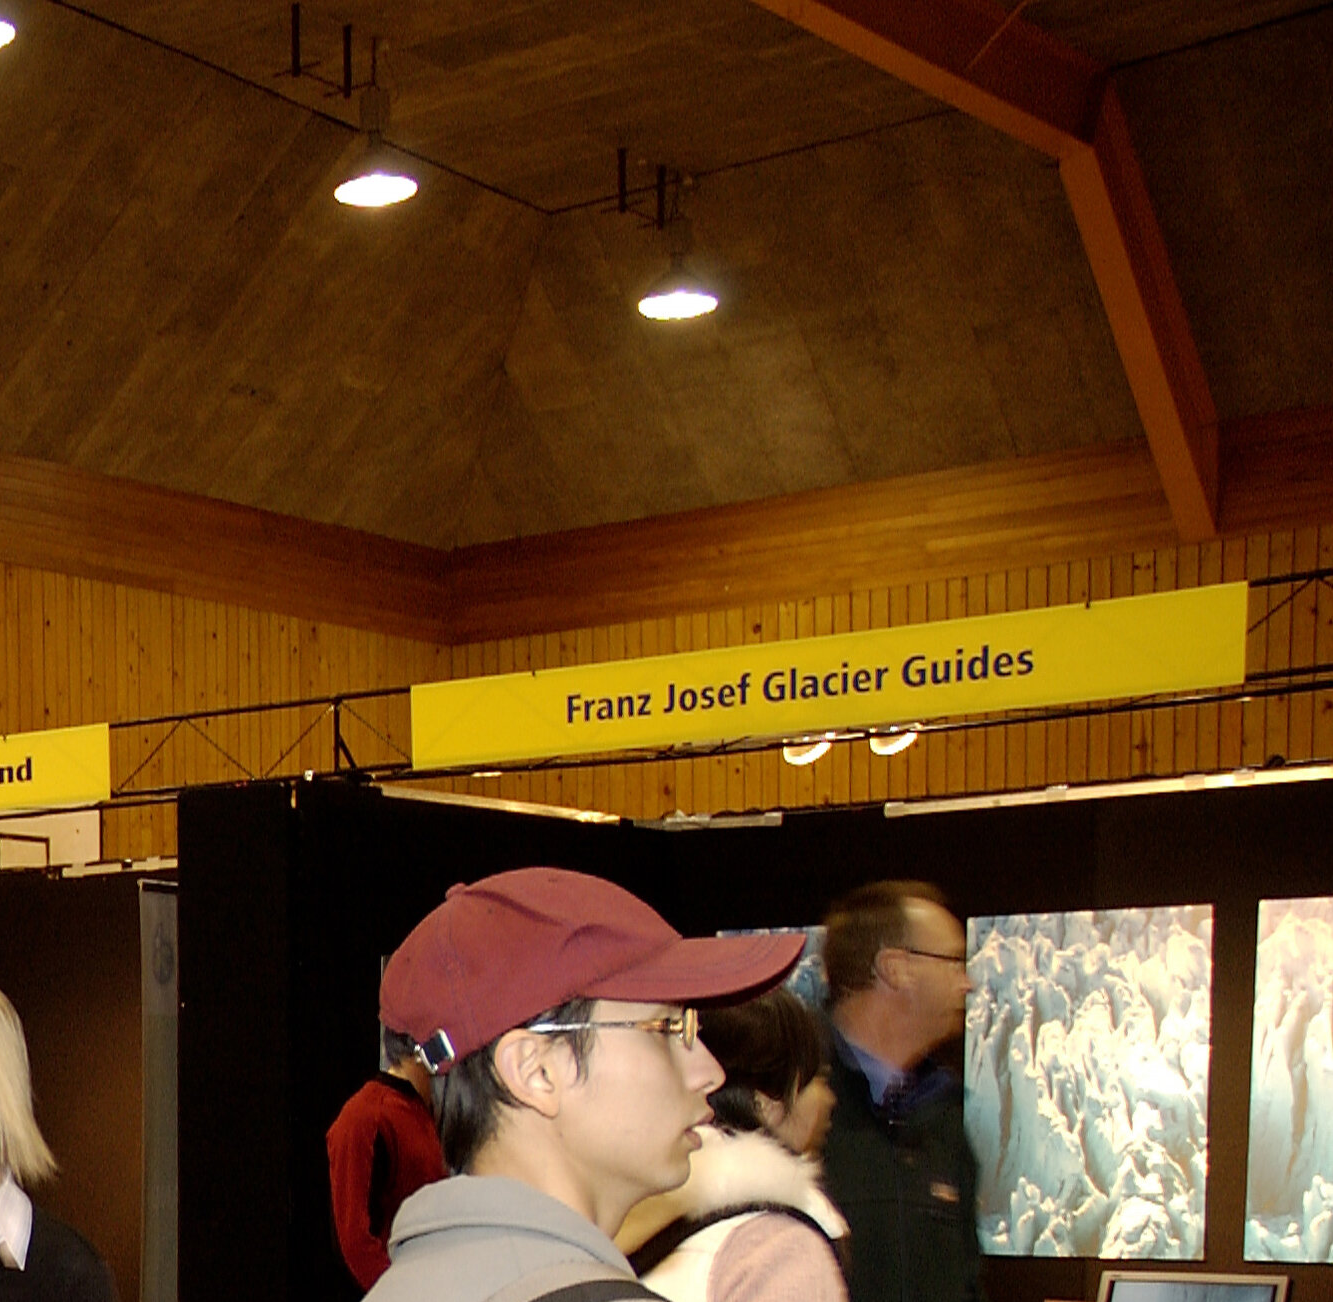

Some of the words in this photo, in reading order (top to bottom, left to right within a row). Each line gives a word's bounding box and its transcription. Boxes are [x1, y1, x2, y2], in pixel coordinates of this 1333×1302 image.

[566, 693, 652, 723] Franz
[663, 672, 751, 713] Josef
[762, 661, 889, 702] Glacier
[901, 645, 1034, 687] Guides
